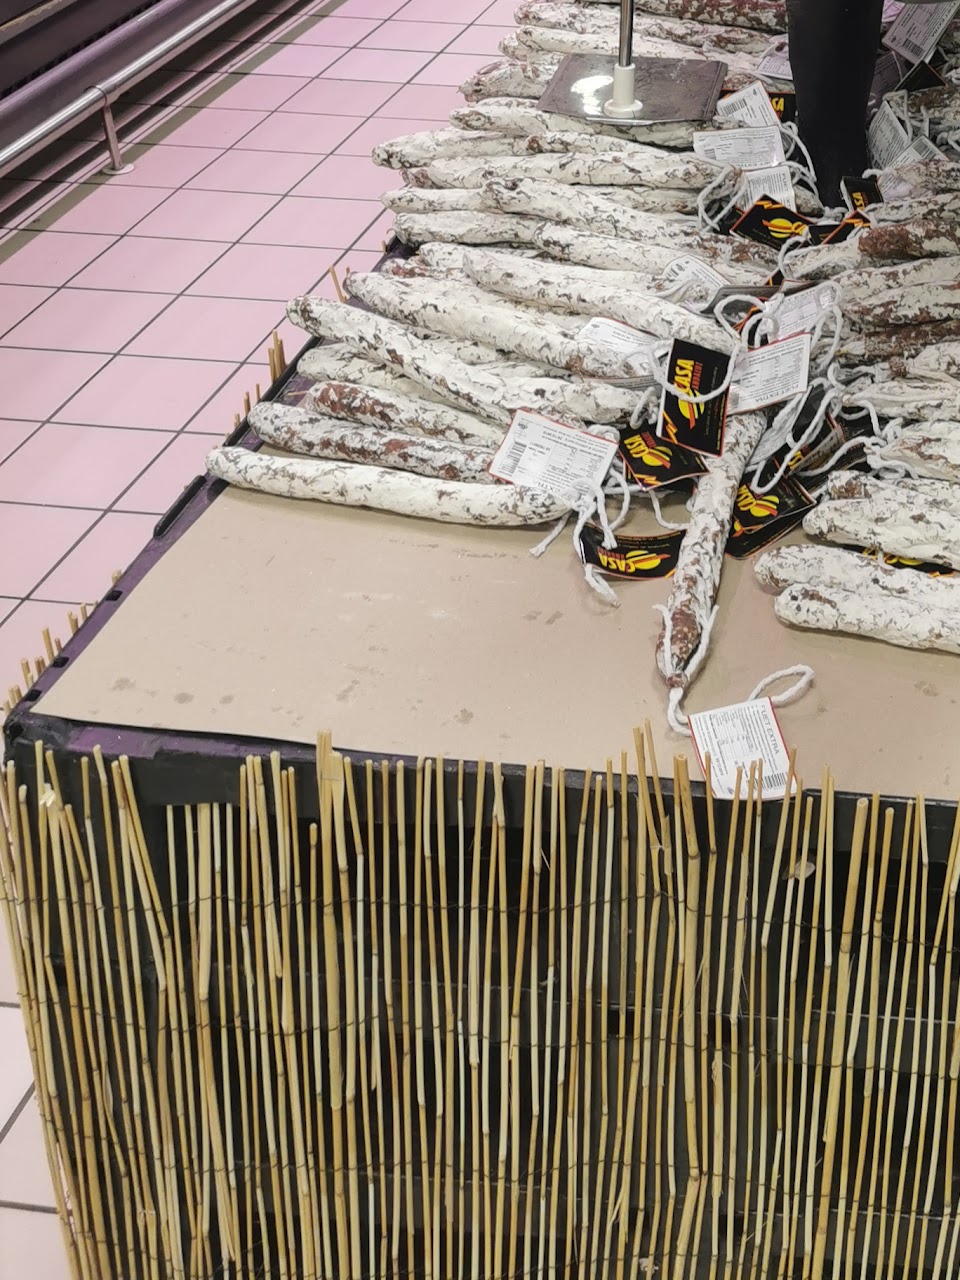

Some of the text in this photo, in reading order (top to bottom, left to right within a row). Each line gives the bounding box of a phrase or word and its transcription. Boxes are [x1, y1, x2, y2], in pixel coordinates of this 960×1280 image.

[623, 434, 650, 459] CASA
[598, 552, 636, 573] CASA
[760, 704, 780, 755] FUET EXTRA
